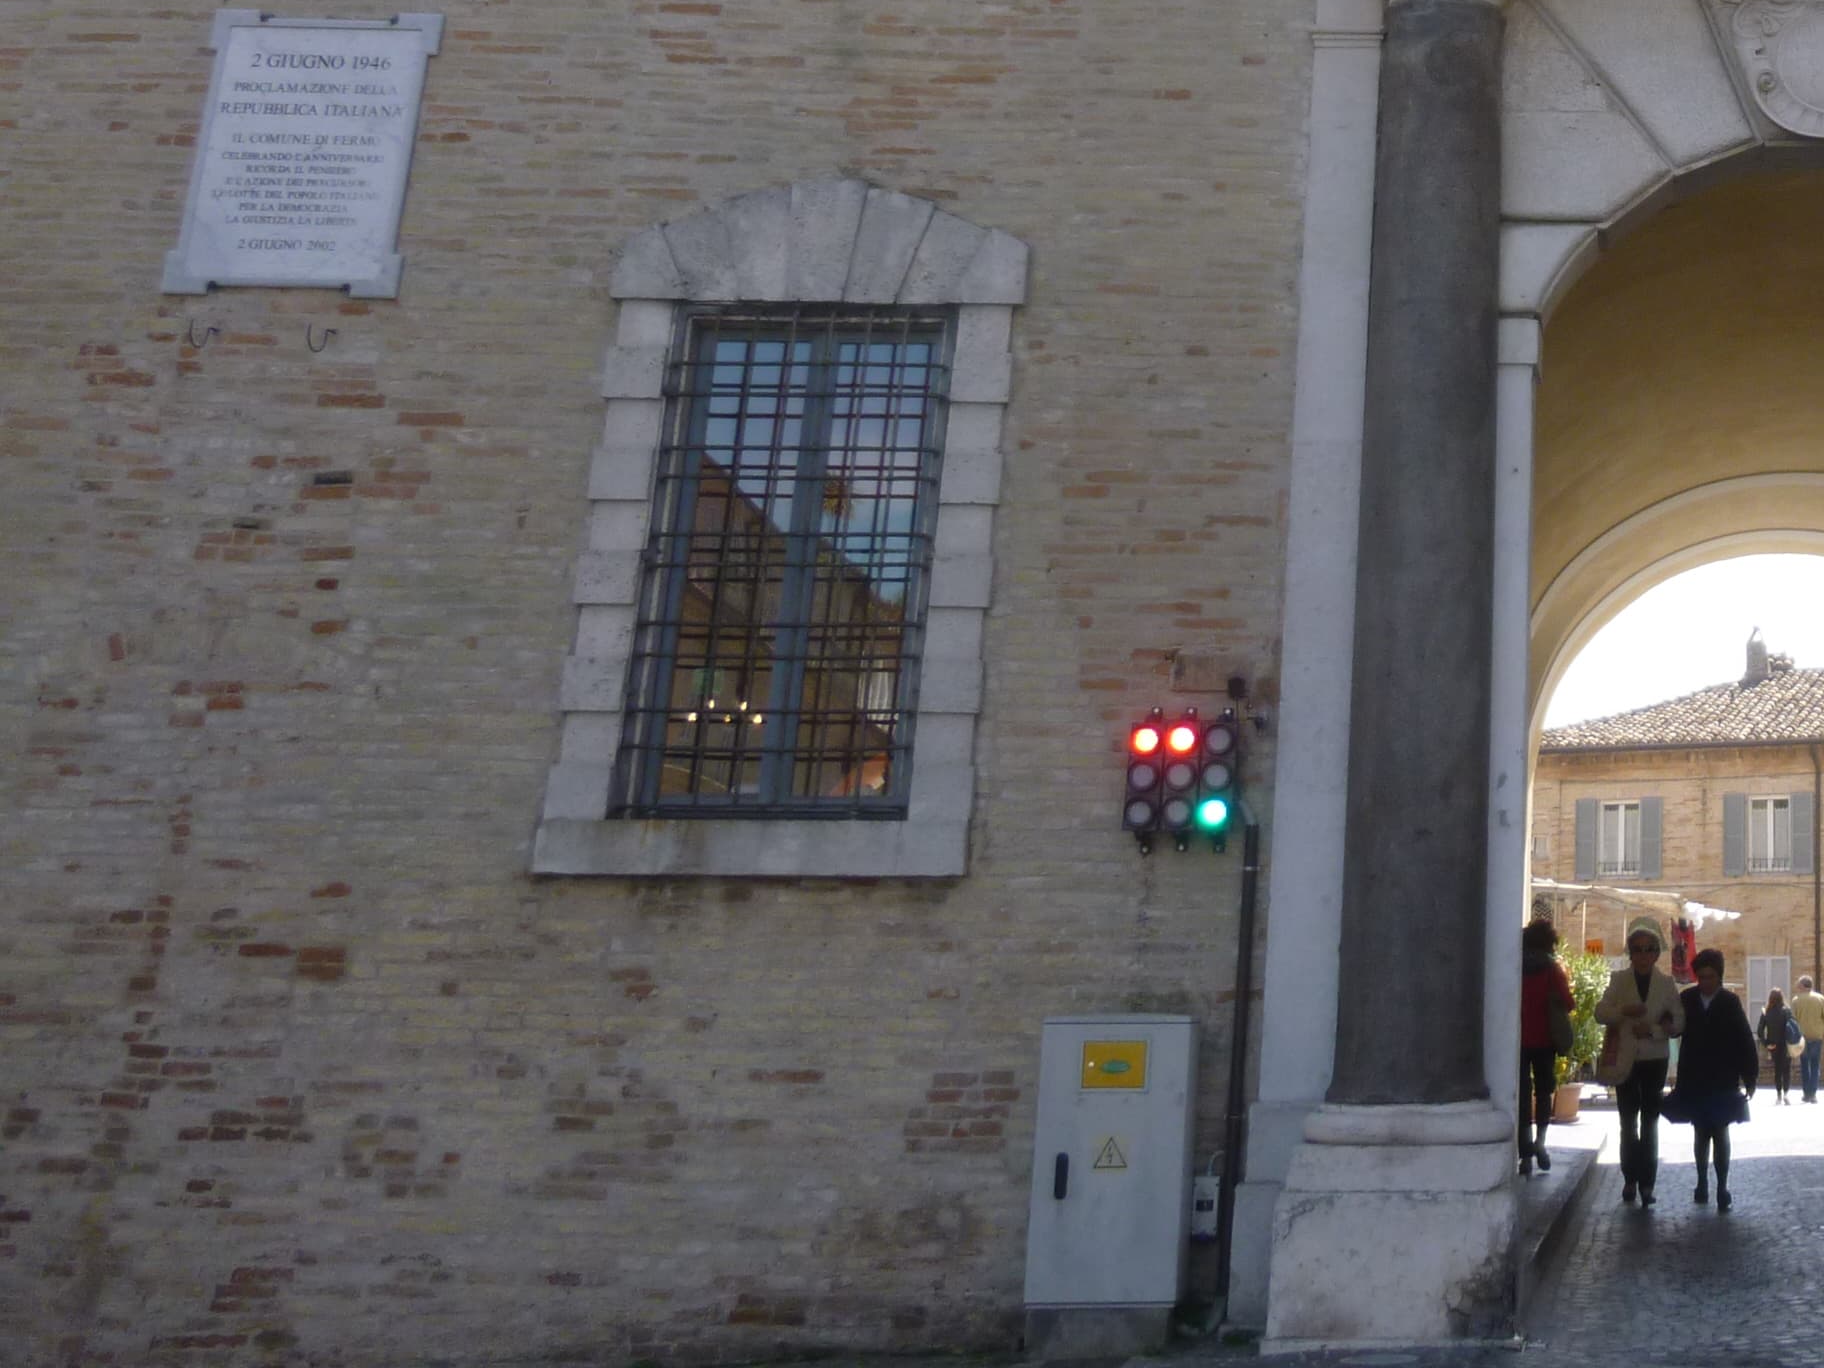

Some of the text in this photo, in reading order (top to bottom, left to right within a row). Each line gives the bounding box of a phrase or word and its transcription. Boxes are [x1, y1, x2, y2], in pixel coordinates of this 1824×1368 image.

[250, 53, 392, 71] 2 GIUGNO 1946
[233, 81, 400, 96] PROCLAMAZIONE DELLA
[219, 102, 406, 118] REPUBBLICA ITALIANA
[231, 133, 383, 146] IL COMUNE DI FERMO
[221, 151, 293, 162] CELEBRANDO
[236, 239, 336, 251] 2 GIUGNO 2002
